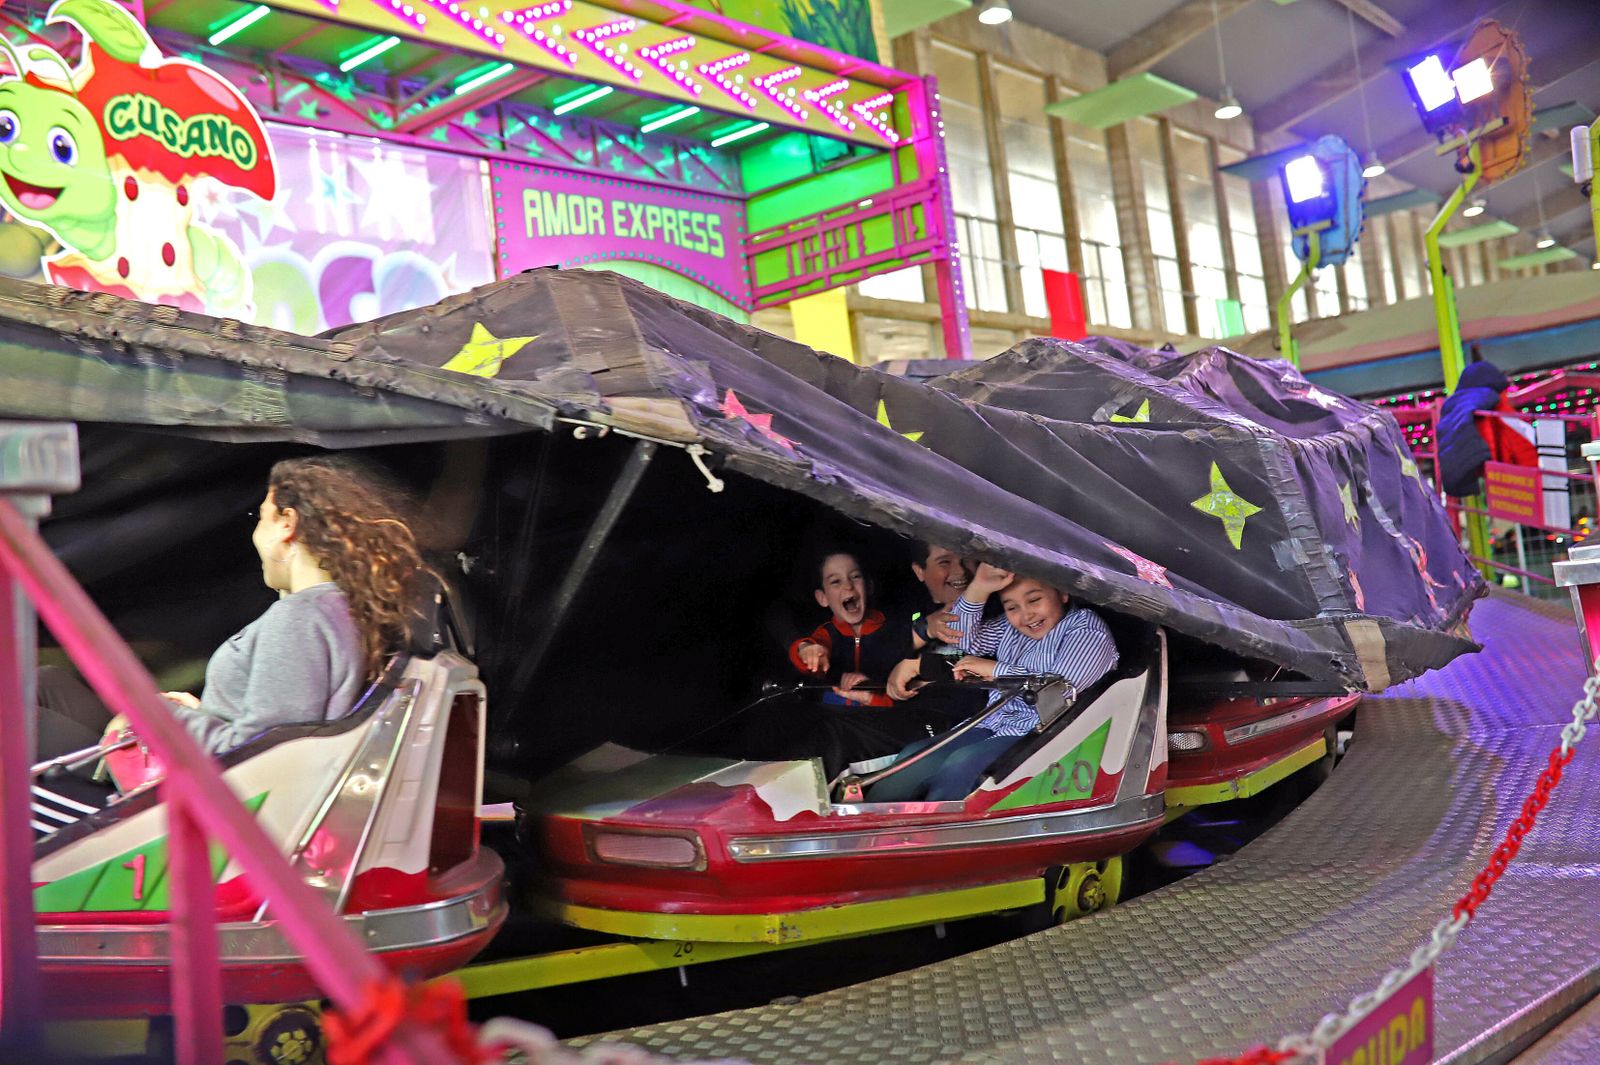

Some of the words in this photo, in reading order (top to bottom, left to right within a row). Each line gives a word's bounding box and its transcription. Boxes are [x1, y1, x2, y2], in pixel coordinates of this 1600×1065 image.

[106, 95, 255, 168] GUSANO
[523, 188, 606, 238] AMOR
[611, 200, 725, 258] EXPRESS
[1047, 760, 1094, 796] 20
[122, 853, 146, 901] 1
[673, 941, 693, 958] 20
